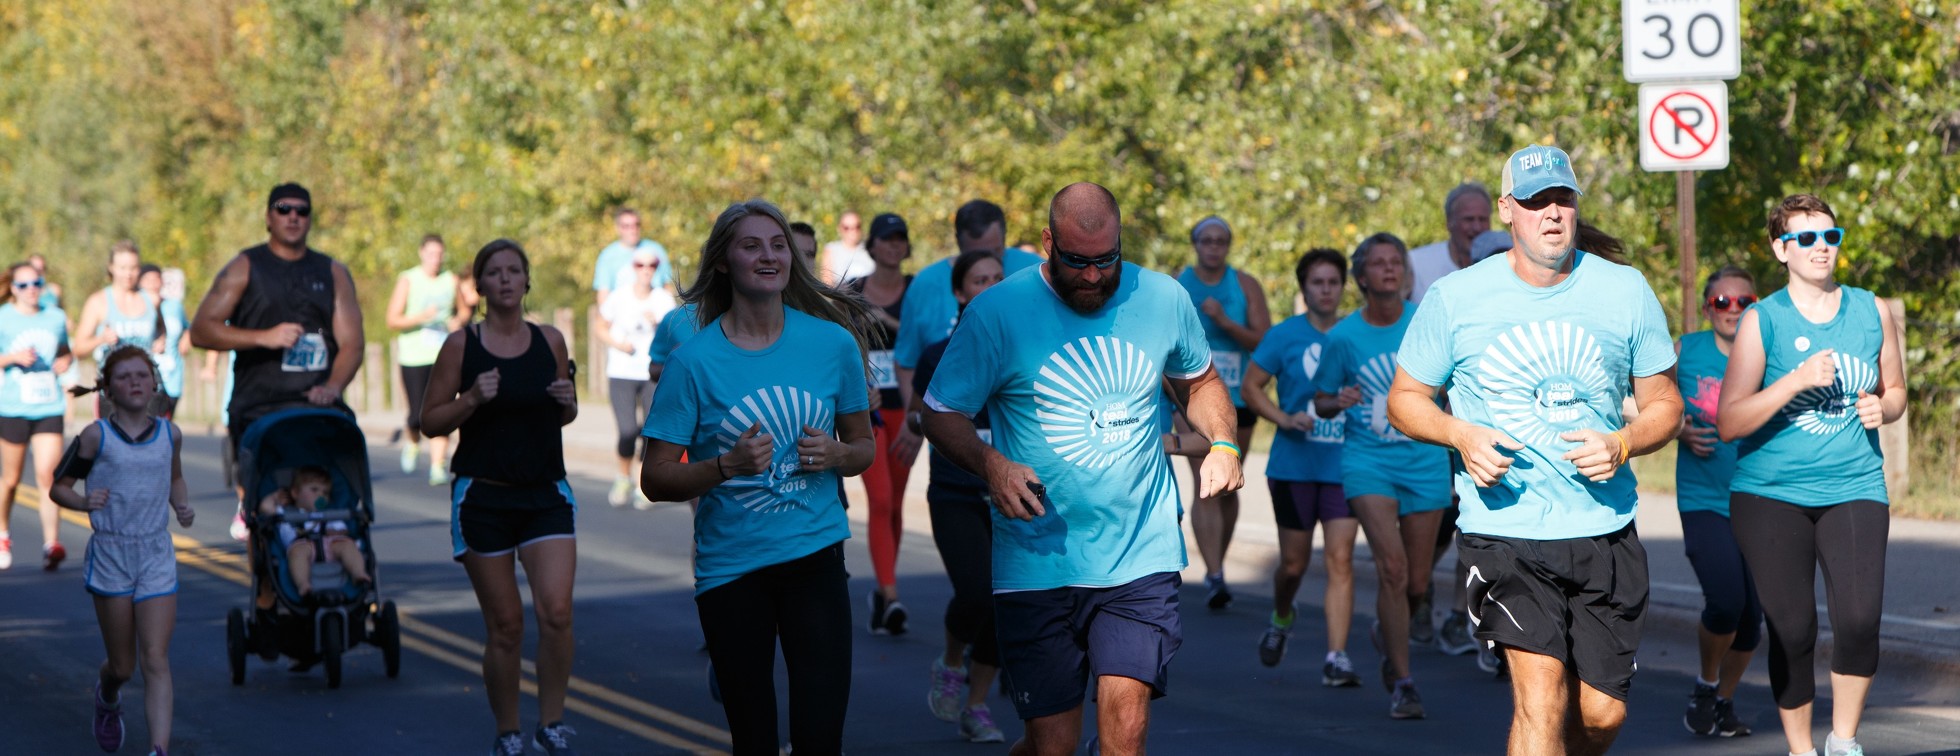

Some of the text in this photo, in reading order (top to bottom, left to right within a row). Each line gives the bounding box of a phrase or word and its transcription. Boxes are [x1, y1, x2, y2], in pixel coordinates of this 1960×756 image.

[1642, 13, 1723, 59] 30
[1519, 151, 1543, 171] TEAM
[1550, 382, 1573, 391] HOM
[1547, 389, 1575, 401] teal
[1557, 397, 1588, 407] strides
[1106, 401, 1126, 411] HOM
[1102, 408, 1128, 422] teal
[1112, 416, 1140, 427] strides
[1548, 408, 1578, 422] 2018
[1102, 430, 1131, 444] 2018
[779, 479, 807, 493] 2018
